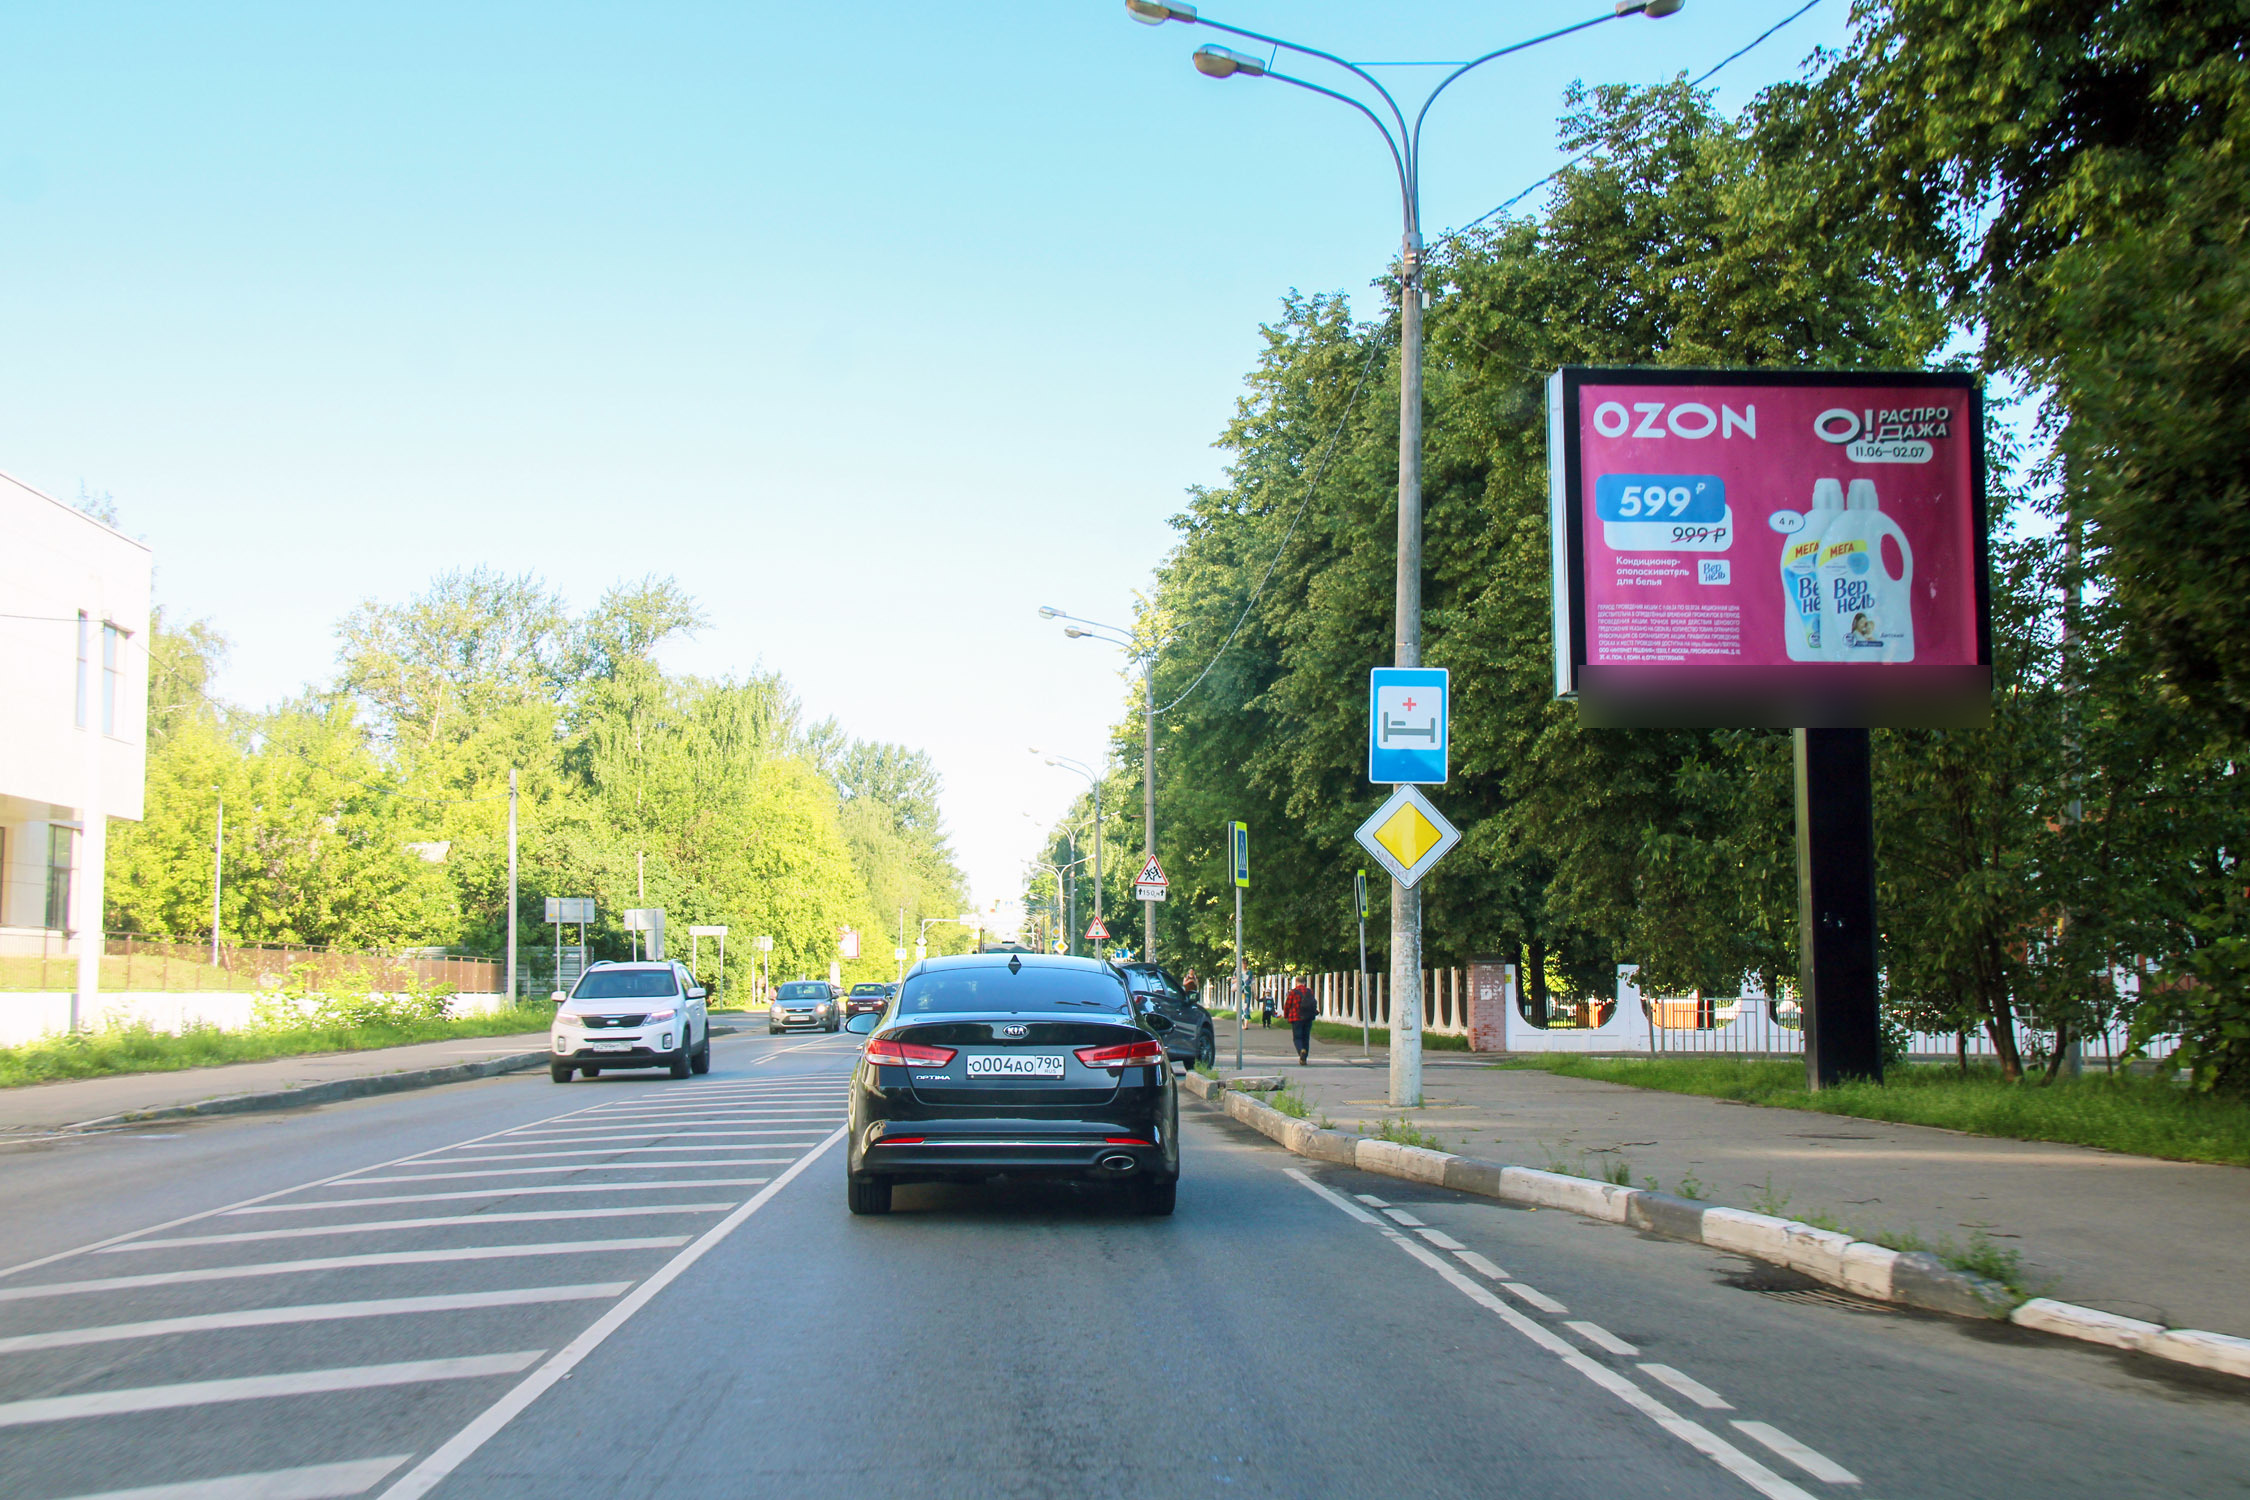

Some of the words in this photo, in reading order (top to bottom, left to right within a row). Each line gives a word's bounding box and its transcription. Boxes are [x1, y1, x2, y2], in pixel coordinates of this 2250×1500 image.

[1593, 401, 1756, 440] OZON
[1879, 406, 1950, 424] РАСПРО
[1876, 422, 1948, 441] ДАЖА
[1618, 486, 1691, 517] 599
[1672, 526, 1708, 543] 999
[1830, 542, 1855, 558] МЕГА
[1616, 556, 1681, 567] Кондиционер-
[1703, 562, 1722, 575] Вер
[1616, 568, 1690, 578] ополаскиватель
[1635, 577, 1662, 586] белья
[1833, 577, 1868, 600] Вер
[1837, 594, 1876, 614] нель
[1007, 1027, 1025, 1035] KIA
